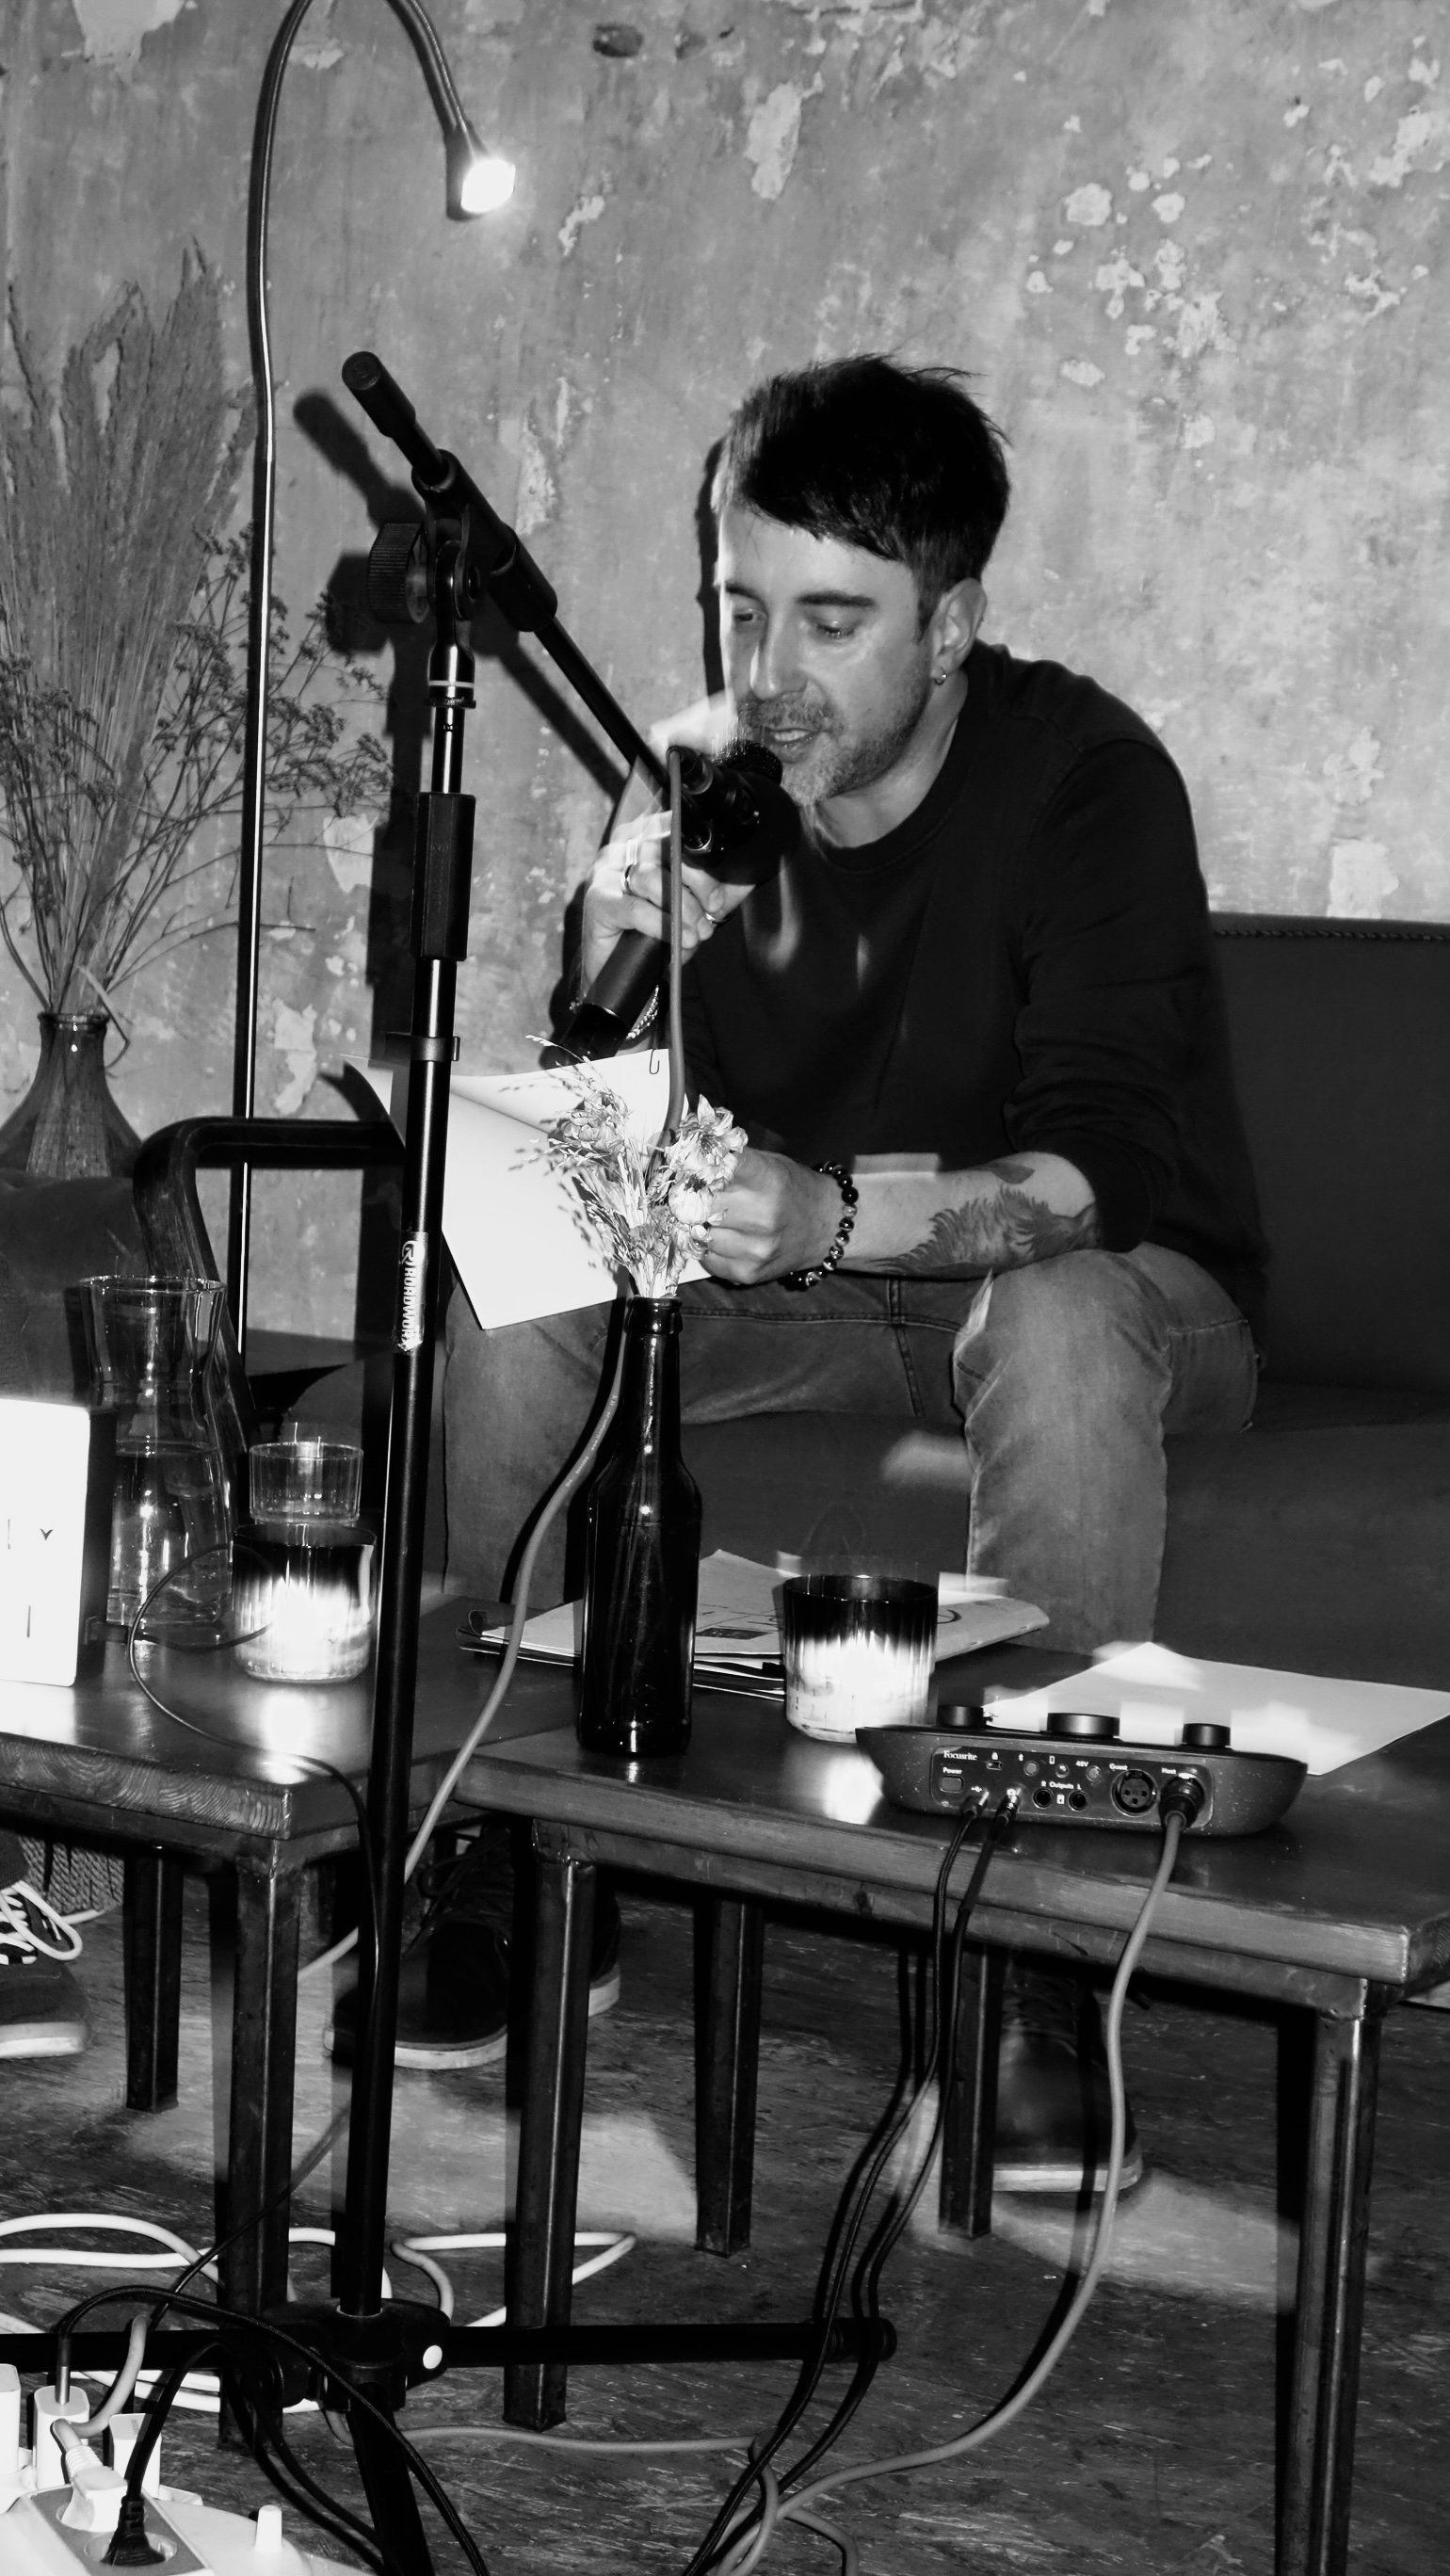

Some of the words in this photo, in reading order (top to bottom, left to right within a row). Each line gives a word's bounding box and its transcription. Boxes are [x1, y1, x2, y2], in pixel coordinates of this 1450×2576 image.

[943, 1750, 977, 1761] Focusrite
[942, 1766, 962, 1775] Power
[1049, 1781, 1074, 1790] Outputs
